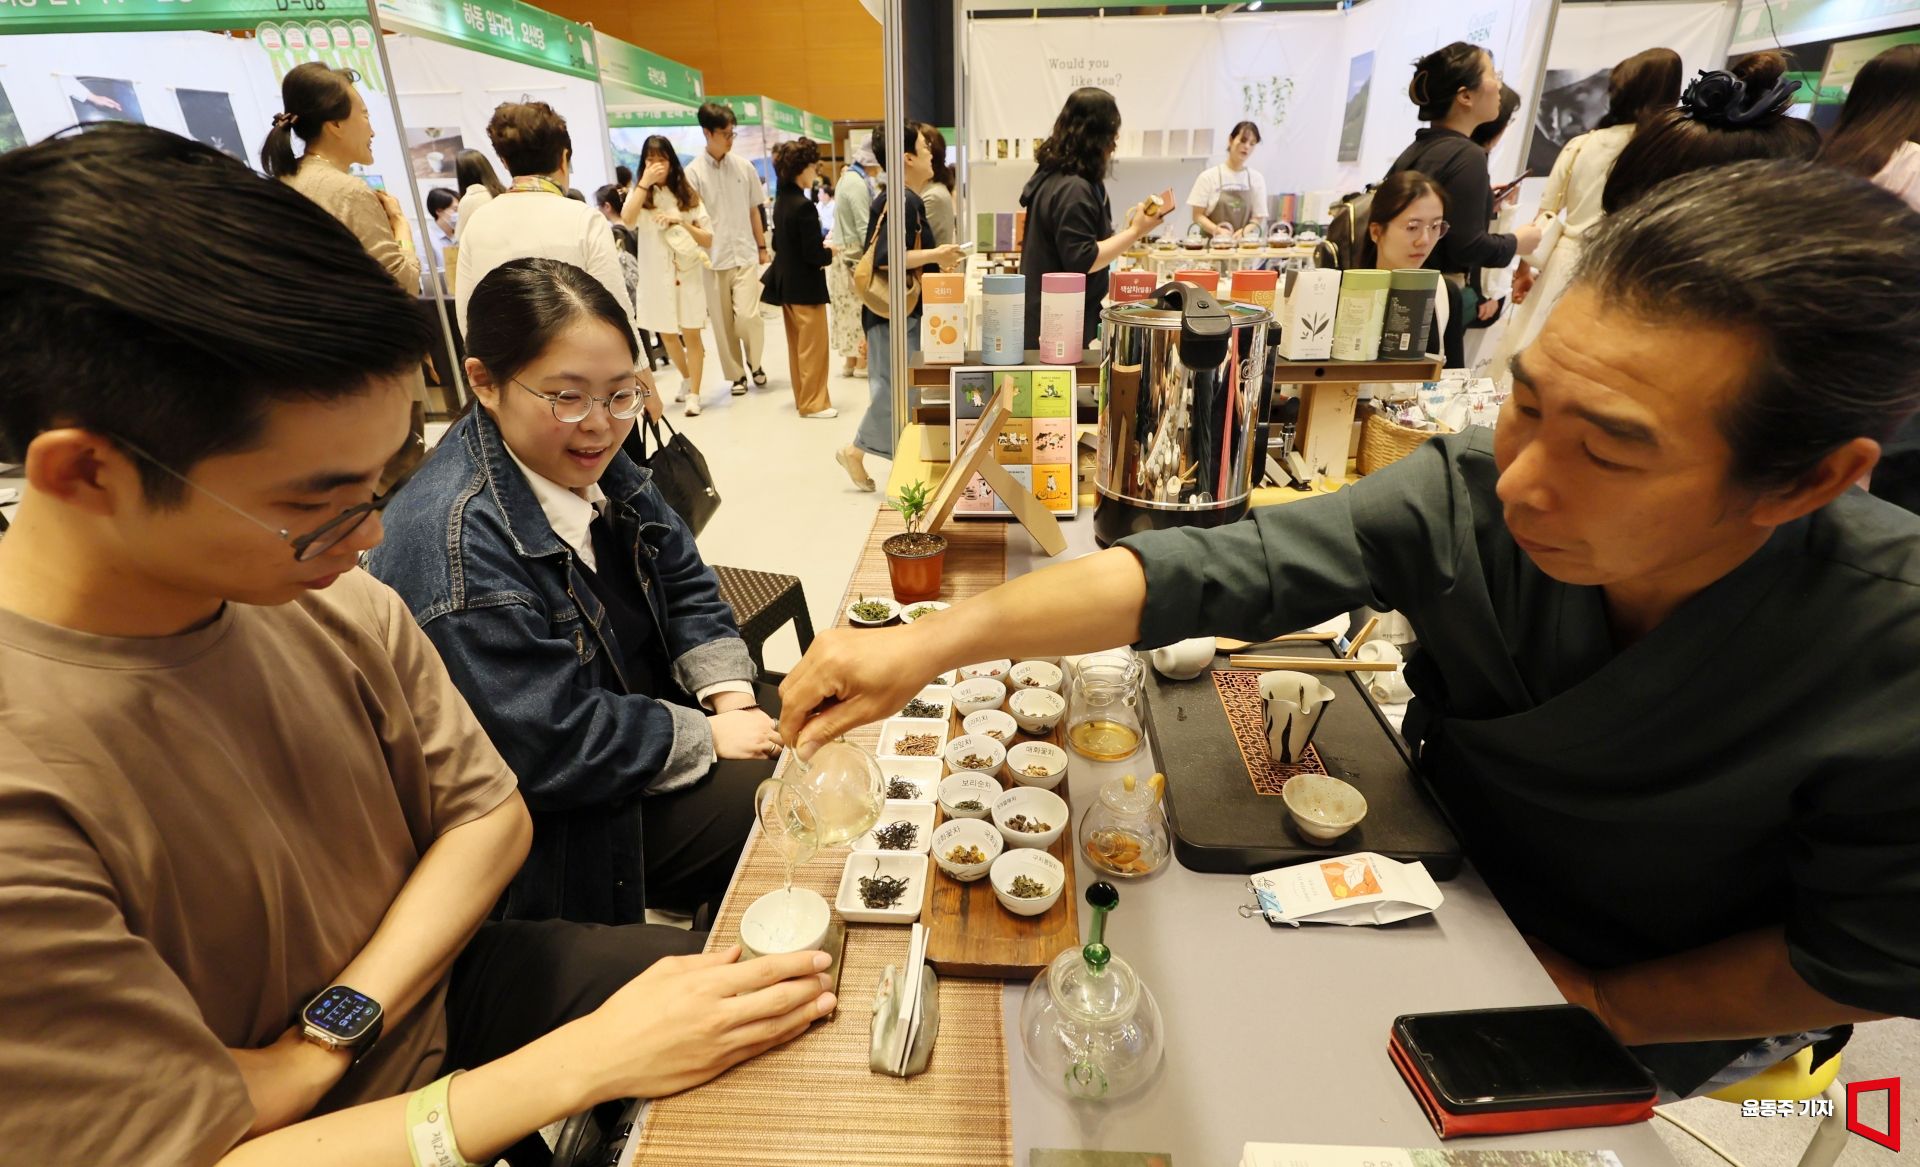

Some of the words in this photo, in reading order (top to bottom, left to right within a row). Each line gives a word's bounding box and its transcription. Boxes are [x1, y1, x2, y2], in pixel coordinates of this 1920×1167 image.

[463, 2, 485, 32] 하동
[1049, 58, 1085, 70] Would
[1088, 58, 1110, 71] you
[1071, 75, 1093, 87] like
[1097, 73, 1122, 87] tea?
[1026, 745, 1055, 757] 매화꽃차
[961, 779, 991, 790] 보리순차
